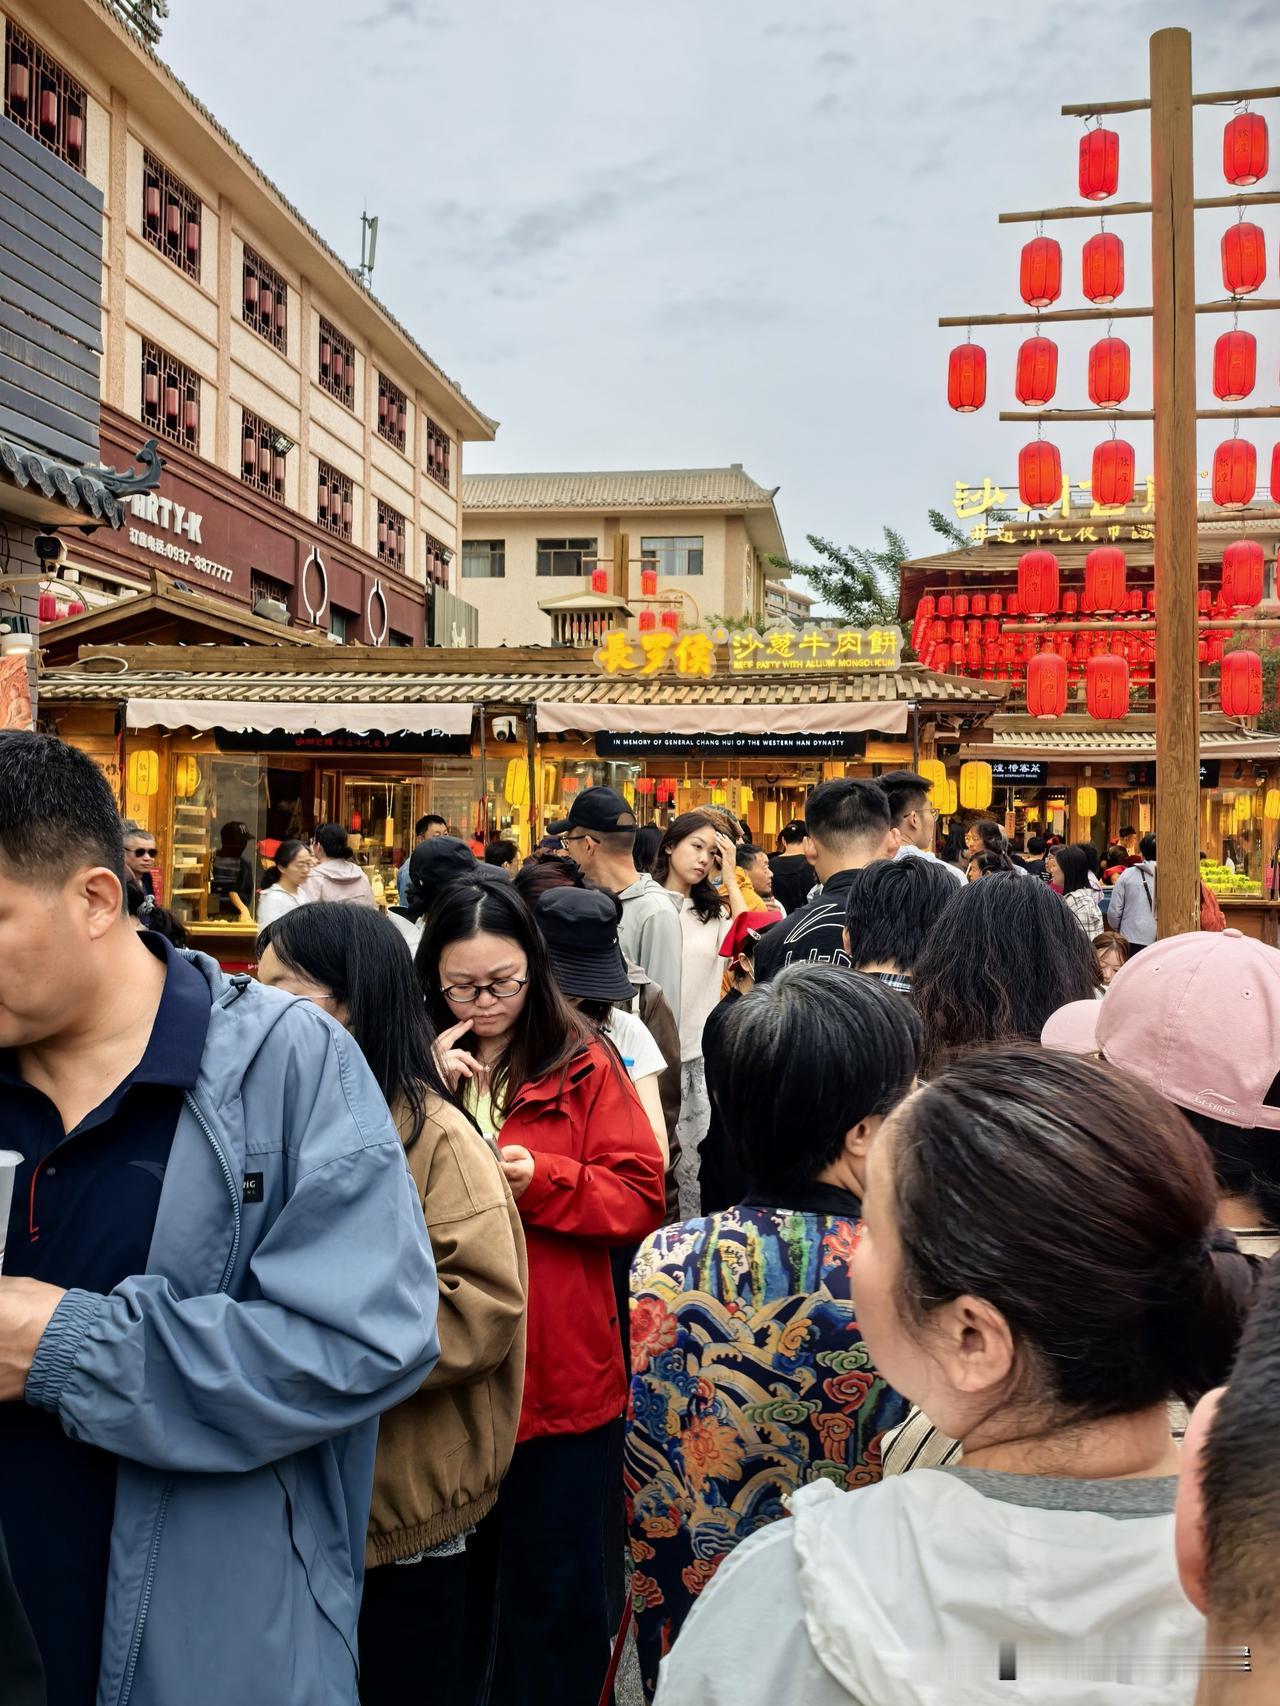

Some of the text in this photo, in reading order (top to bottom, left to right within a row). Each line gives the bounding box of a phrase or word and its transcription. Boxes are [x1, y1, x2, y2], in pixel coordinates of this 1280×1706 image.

[733, 658, 895, 669] BEEF PATTY WITH ALLIUM MONGOLICUM
